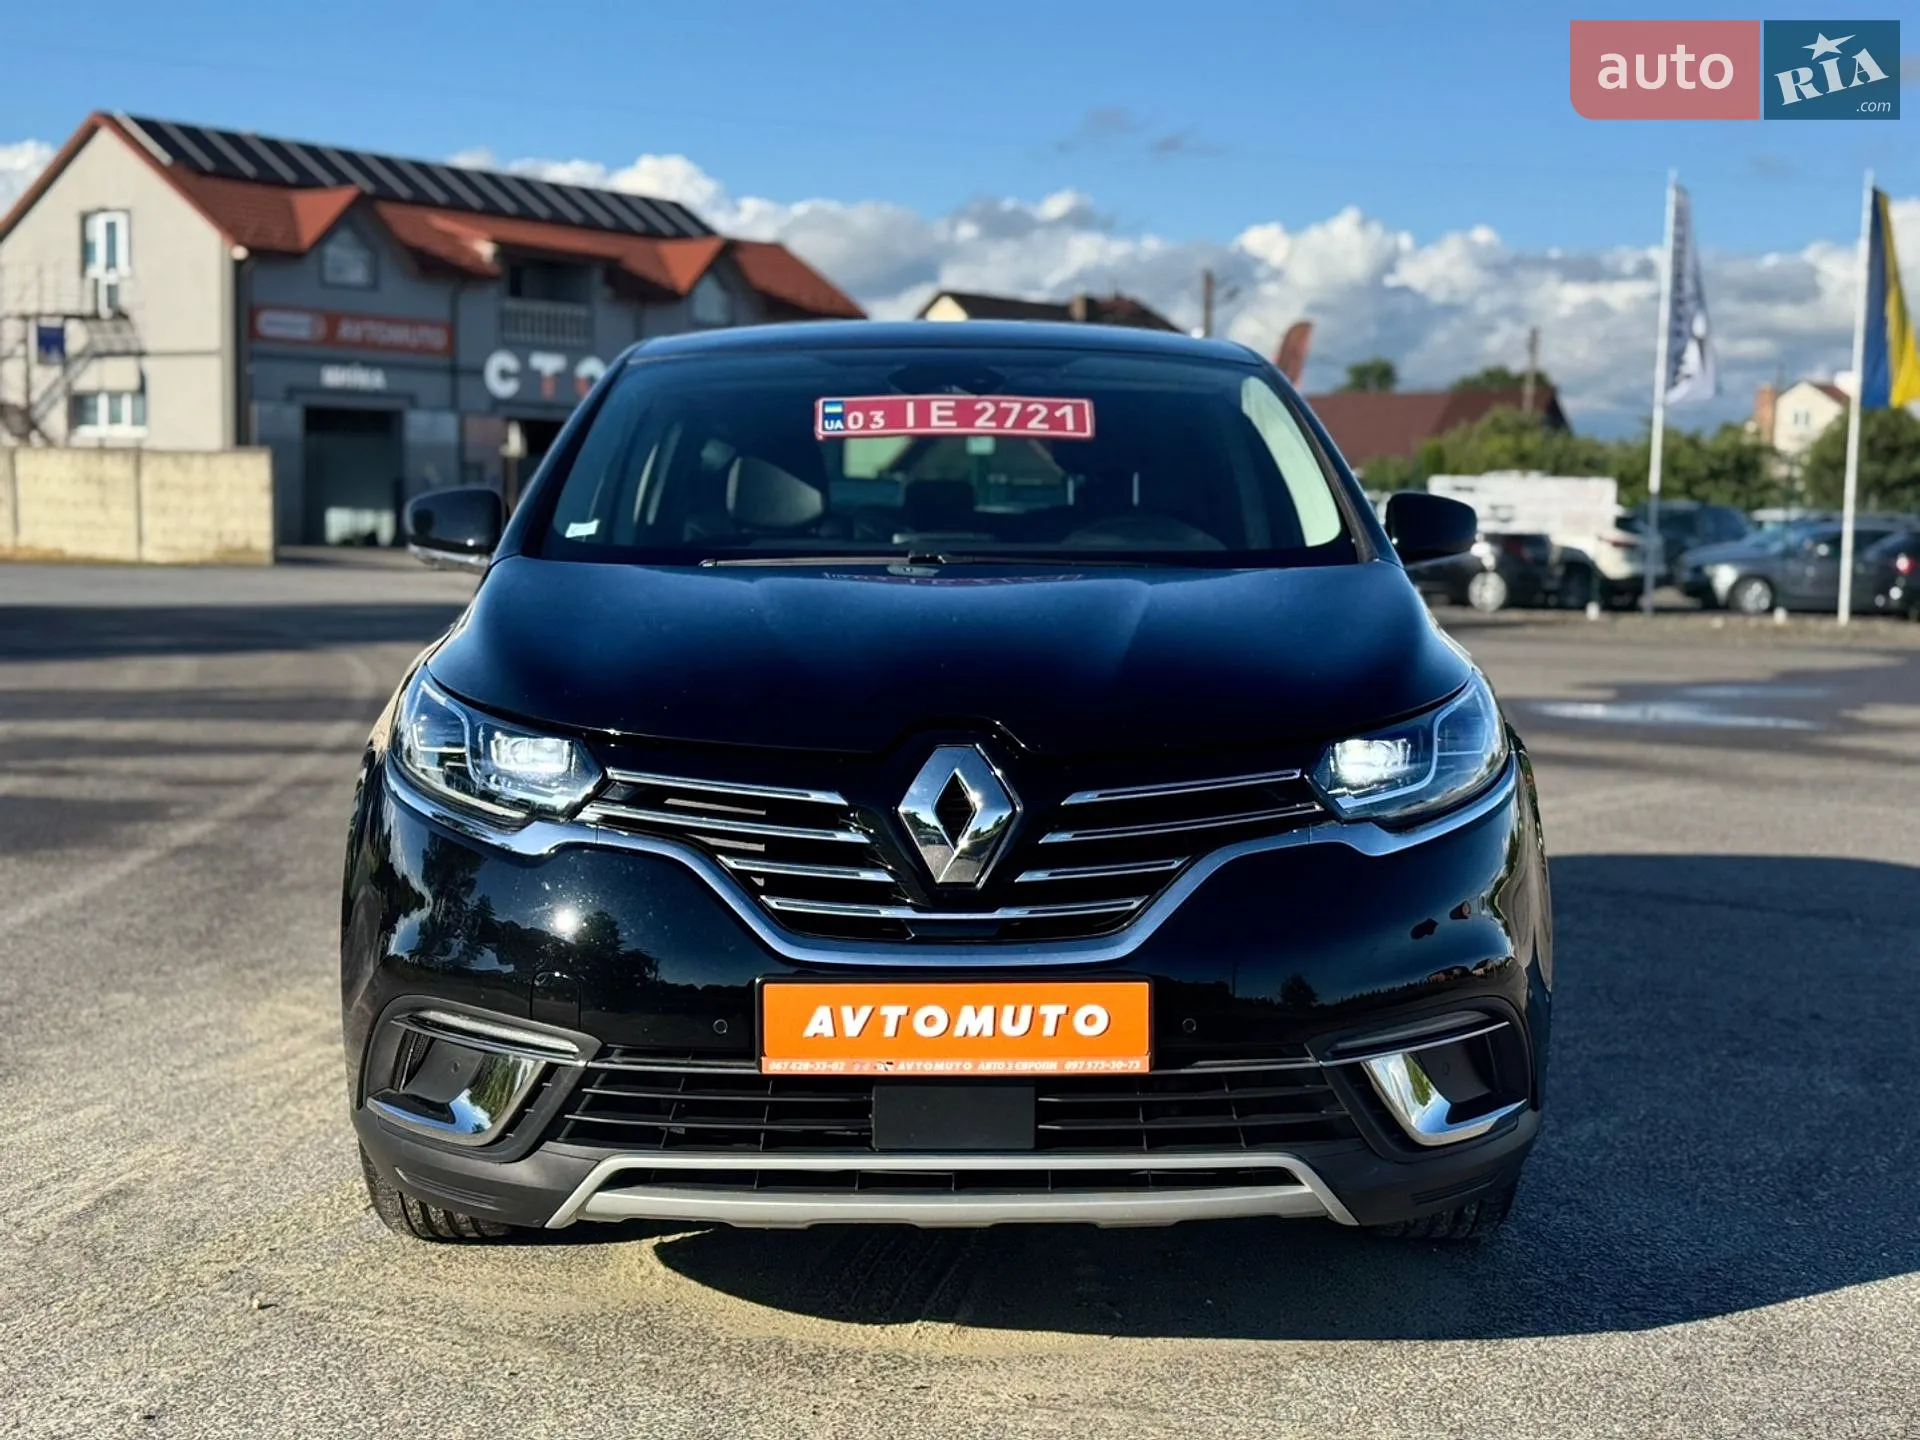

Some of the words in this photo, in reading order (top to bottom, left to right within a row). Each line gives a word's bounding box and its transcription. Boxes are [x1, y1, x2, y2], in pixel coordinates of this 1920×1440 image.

[824, 420, 844, 430] UA
[847, 411, 885, 430] 03
[906, 401, 957, 428] IE
[973, 401, 1075, 431] 2721
[803, 1004, 1111, 1038] AVTOMUTO
[896, 1061, 973, 1072] AVTOMUTO
